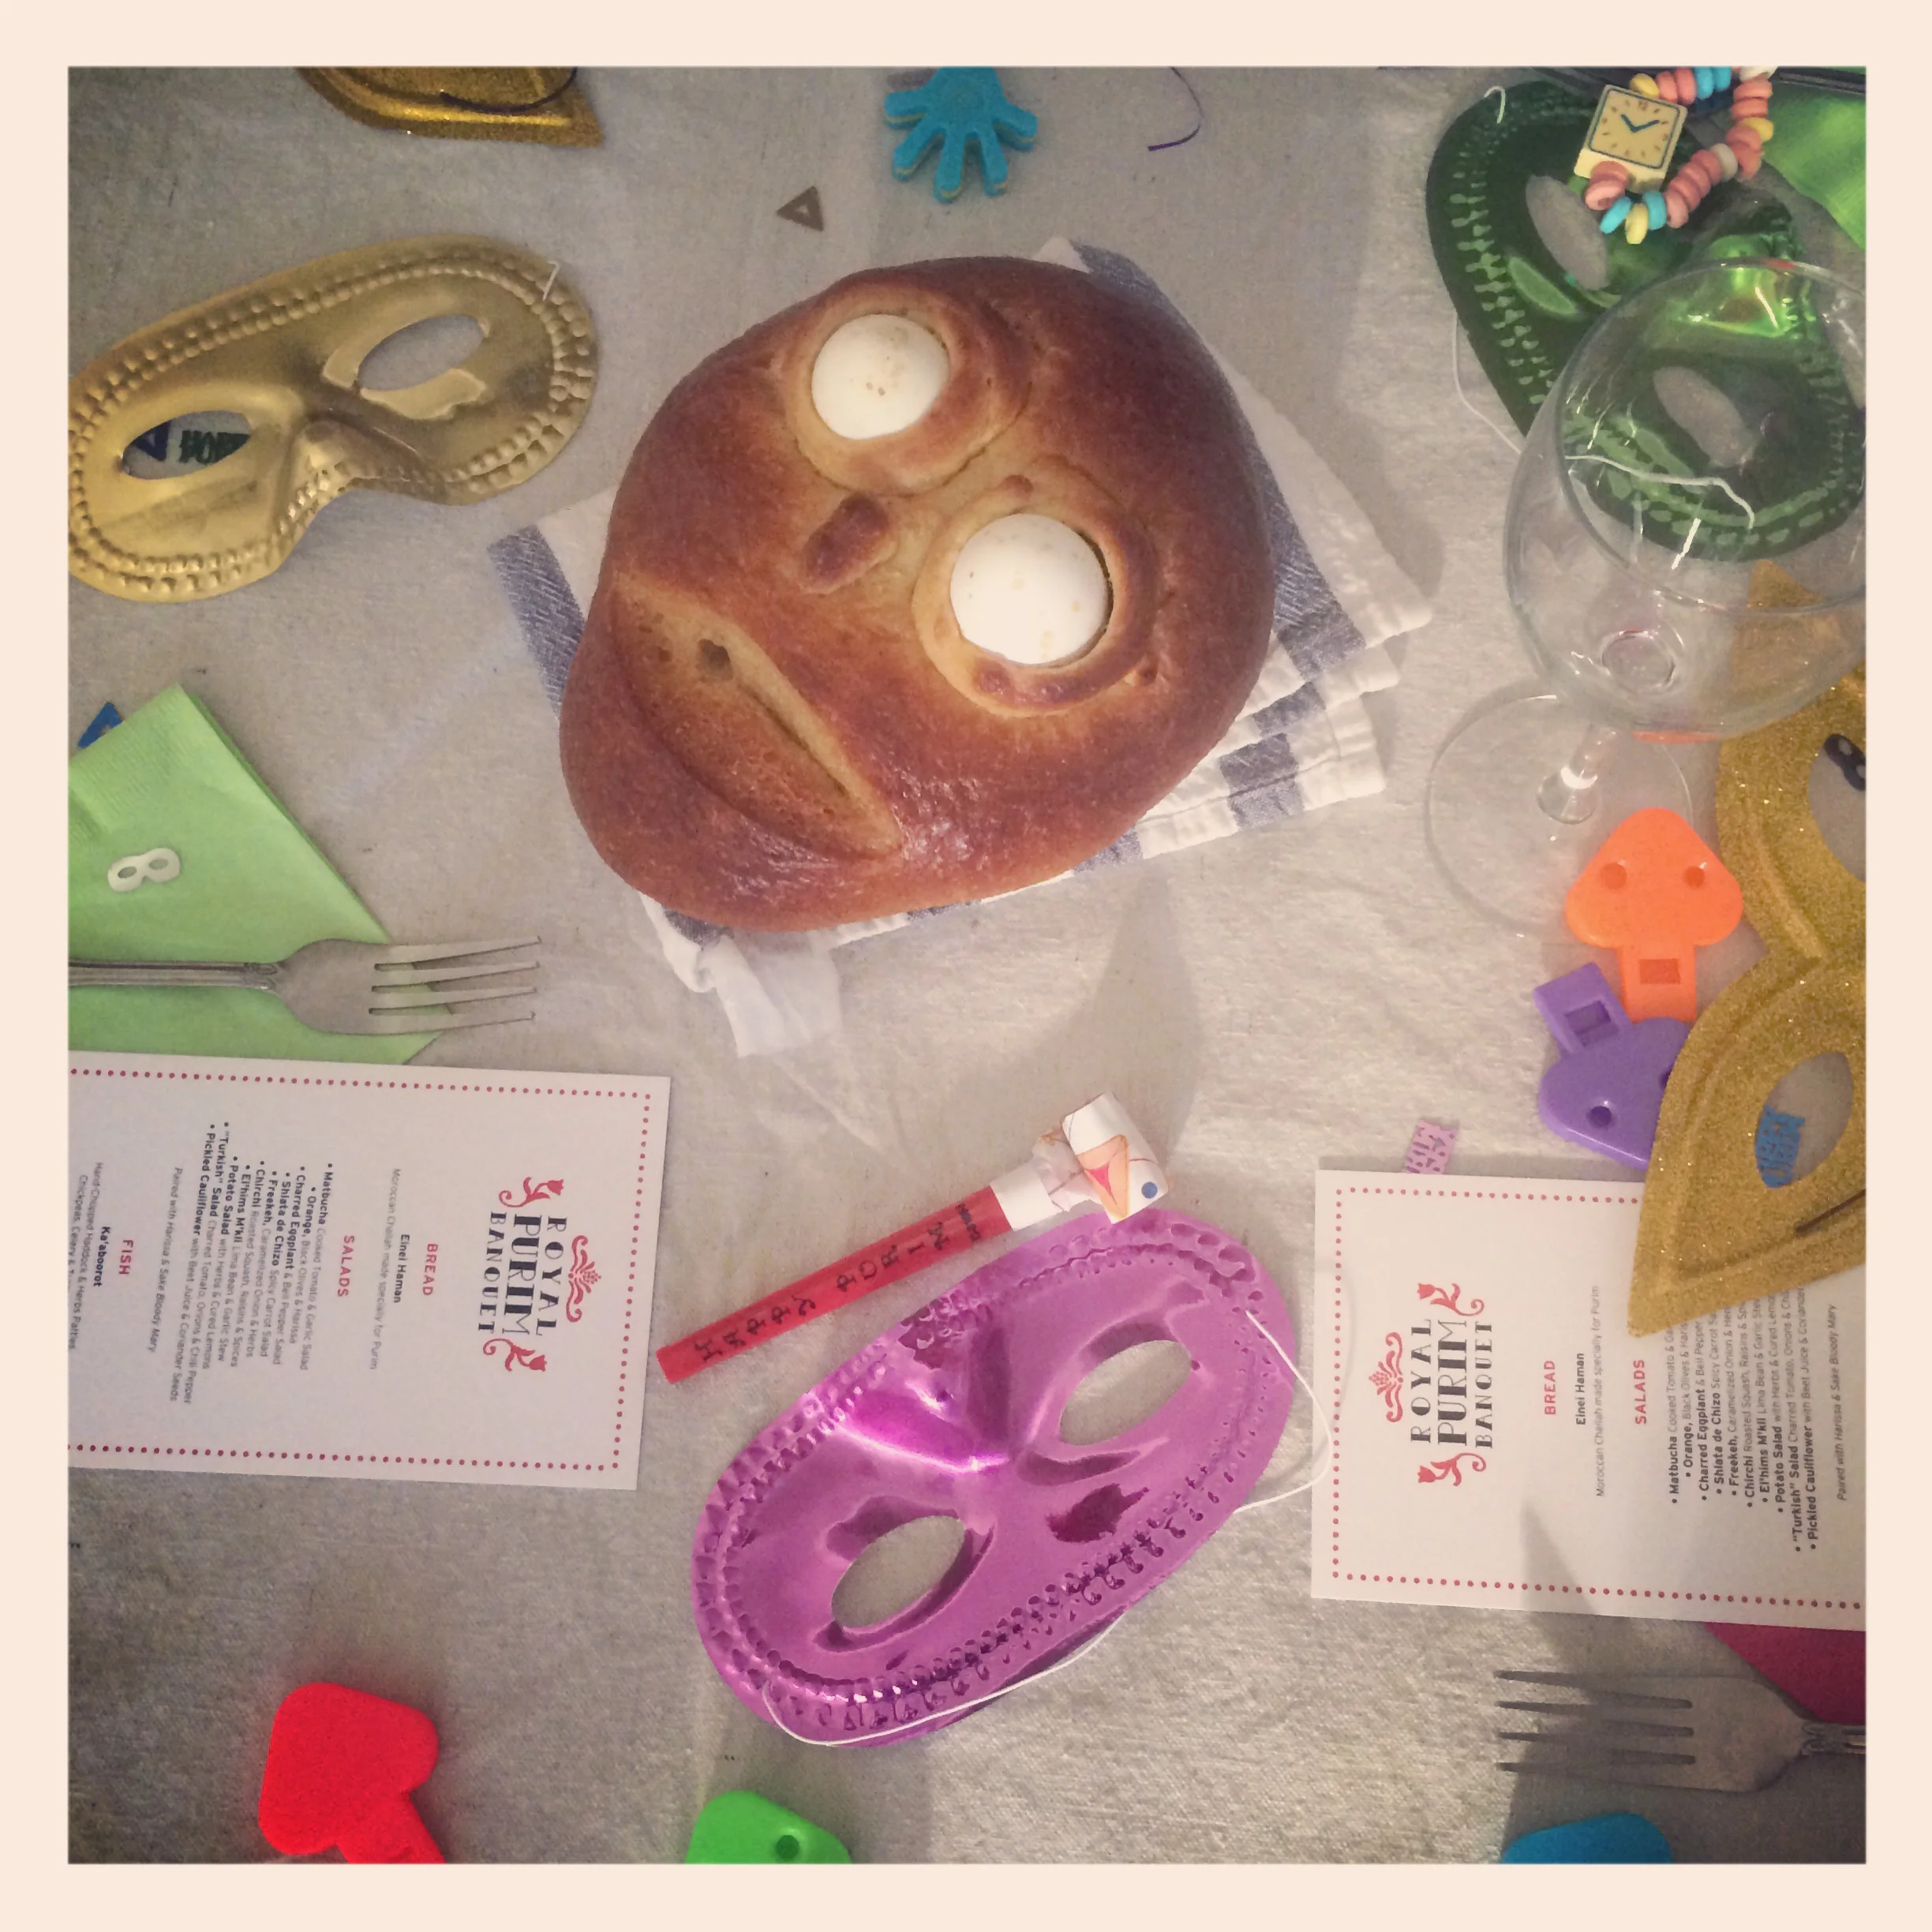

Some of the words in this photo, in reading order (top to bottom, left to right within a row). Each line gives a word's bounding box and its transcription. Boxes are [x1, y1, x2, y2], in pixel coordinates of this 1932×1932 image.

[201, 1133, 215, 1171] Pickled
[170, 1166, 182, 1197] Paired
[225, 1164, 238, 1200] Potato
[291, 1174, 305, 1217] Charred
[318, 1171, 333, 1224] Matbucha
[388, 1168, 401, 1213] Moroccan
[193, 1174, 209, 1235] Cauliflower
[209, 1187, 222, 1216] Salad
[262, 1179, 278, 1225] Freekeh,
[277, 1181, 290, 1215] Shlata
[220, 1205, 233, 1234] Salad
[246, 1211, 259, 1249] Roasted
[276, 1219, 286, 1231] de
[301, 1196, 316, 1237] Orange,
[67, 1226, 80, 1256] Celery
[79, 1233, 93, 1273] Haddock
[162, 1222, 174, 1256] Harissa
[189, 1237, 199, 1258] with
[204, 1220, 216, 1257] Charred
[218, 1238, 227, 1258] with
[271, 1235, 283, 1266] Chizo
[285, 1221, 300, 1269] Eggplant
[300, 1240, 310, 1264] Black
[313, 1227, 325, 1263] Cooked
[398, 1234, 410, 1260] Einei
[118, 1239, 133, 1275] FISH
[185, 1260, 197, 1282] Beet
[229, 1246, 240, 1268] Lima
[337, 1235, 354, 1297] SALADS
[380, 1252, 389, 1279] made
[422, 1243, 438, 1295] BREAD
[477, 1211, 507, 1332] BANQUET
[157, 1267, 168, 1290] Sake
[213, 1260, 224, 1288] Herbs
[227, 1271, 237, 1295] Bean
[267, 1269, 279, 1294] Spicy
[281, 1281, 291, 1299] Bell
[294, 1267, 307, 1296] Olives
[309, 1266, 321, 1301] Tomato
[393, 1264, 406, 1302] Haman
[501, 1214, 541, 1335] PURIM
[536, 1216, 567, 1335] ROYAL
[73, 1285, 84, 1313] Herbs
[182, 1284, 193, 1310] Juice
[251, 1289, 263, 1316] Onion
[374, 1281, 386, 1321] specially
[694, 1296, 817, 1361] HAPPY
[837, 1221, 950, 1292] PURIM
[1590, 1286, 1599, 1314] Purim
[151, 1293, 165, 1326] Bloody
[192, 1301, 205, 1335] Onions
[208, 1300, 219, 1329] Cured
[220, 1308, 233, 1334] Garlic
[264, 1297, 275, 1327] Carrot
[276, 1301, 289, 1335] Pepper
[1590, 1317, 1601, 1331] for
[1827, 1304, 1837, 1328] Mary
[147, 1327, 159, 1352] Mary
[289, 1309, 301, 1343] Harissa
[303, 1313, 315, 1341] Garlic
[373, 1324, 384, 1338] for
[1694, 1322, 1704, 1354] Pepper
[1753, 1322, 1762, 1349] Garlic
[1768, 1327, 1778, 1357] Cured
[1783, 1322, 1793, 1355] Onions
[174, 1322, 189, 1369] Coriander
[202, 1331, 215, 1369] Lemons
[217, 1338, 228, 1361] Stew
[230, 1336, 242, 1367] Spices
[245, 1329, 258, 1357] Herbs
[259, 1331, 271, 1357] Salad
[272, 1338, 284, 1365] Salad
[299, 1344, 312, 1370] Salad
[369, 1341, 381, 1369] Purim
[1591, 1335, 1602, 1376] specially
[1709, 1328, 1719, 1360] Carrot
[1724, 1339, 1733, 1368] Onion
[1828, 1331, 1838, 1365] Bloody
[1574, 1353, 1584, 1392] Haman
[1666, 1354, 1675, 1392] Tomato
[1680, 1360, 1690, 1390] Olives
[1695, 1357, 1704, 1376] Bell
[1710, 1363, 1720, 1388] Spicy
[1754, 1362, 1765, 1387] Bean
[1800, 1346, 1809, 1373] Juice
[169, 1372, 182, 1401] Seeds
[183, 1370, 197, 1403] Pepper
[1410, 1319, 1431, 1443] ROYAL
[1437, 1320, 1466, 1446] PURIM
[1474, 1321, 1492, 1448] BANQUET
[1543, 1360, 1556, 1414] BREAD
[1593, 1378, 1602, 1406] made
[1632, 1360, 1646, 1425] SALADS
[1740, 1370, 1750, 1407] Squash,
[1770, 1369, 1780, 1398] Herbs
[1784, 1358, 1795, 1398] Tomato,
[1800, 1376, 1810, 1398] Beet
[1830, 1367, 1840, 1391] Sake
[1574, 1397, 1586, 1425] Einei
[1666, 1395, 1677, 1432] Cooked
[1682, 1393, 1690, 1419] Black
[1694, 1388, 1708, 1440] Eggplant
[1710, 1392, 1720, 1425] Chizo
[1757, 1389, 1767, 1413] Lima
[1772, 1401, 1780, 1421] with
[1802, 1402, 1811, 1422] with
[1712, 1428, 1722, 1442] de
[1742, 1410, 1752, 1451] Roasted
[1786, 1402, 1798, 1442] Charred
[1833, 1403, 1843, 1440] Harissa
[1683, 1422, 1694, 1467] Orange,
[1771, 1425, 1783, 1458] Salad
[1834, 1443, 1844, 1465] with
[1595, 1447, 1604, 1496] Moroccan
[1668, 1436, 1679, 1494] Matbucha
[1697, 1443, 1709, 1491] Charred
[1713, 1446, 1724, 1484] Shlata
[1727, 1435, 1739, 1486] Freekeh,
[1787, 1445, 1799, 1477] Salad
[1803, 1425, 1816, 1492] Cauliflower
[1773, 1462, 1785, 1503] Potato
[1835, 1466, 1847, 1500] Paired
[1806, 1496, 1818, 1540] Pickled
